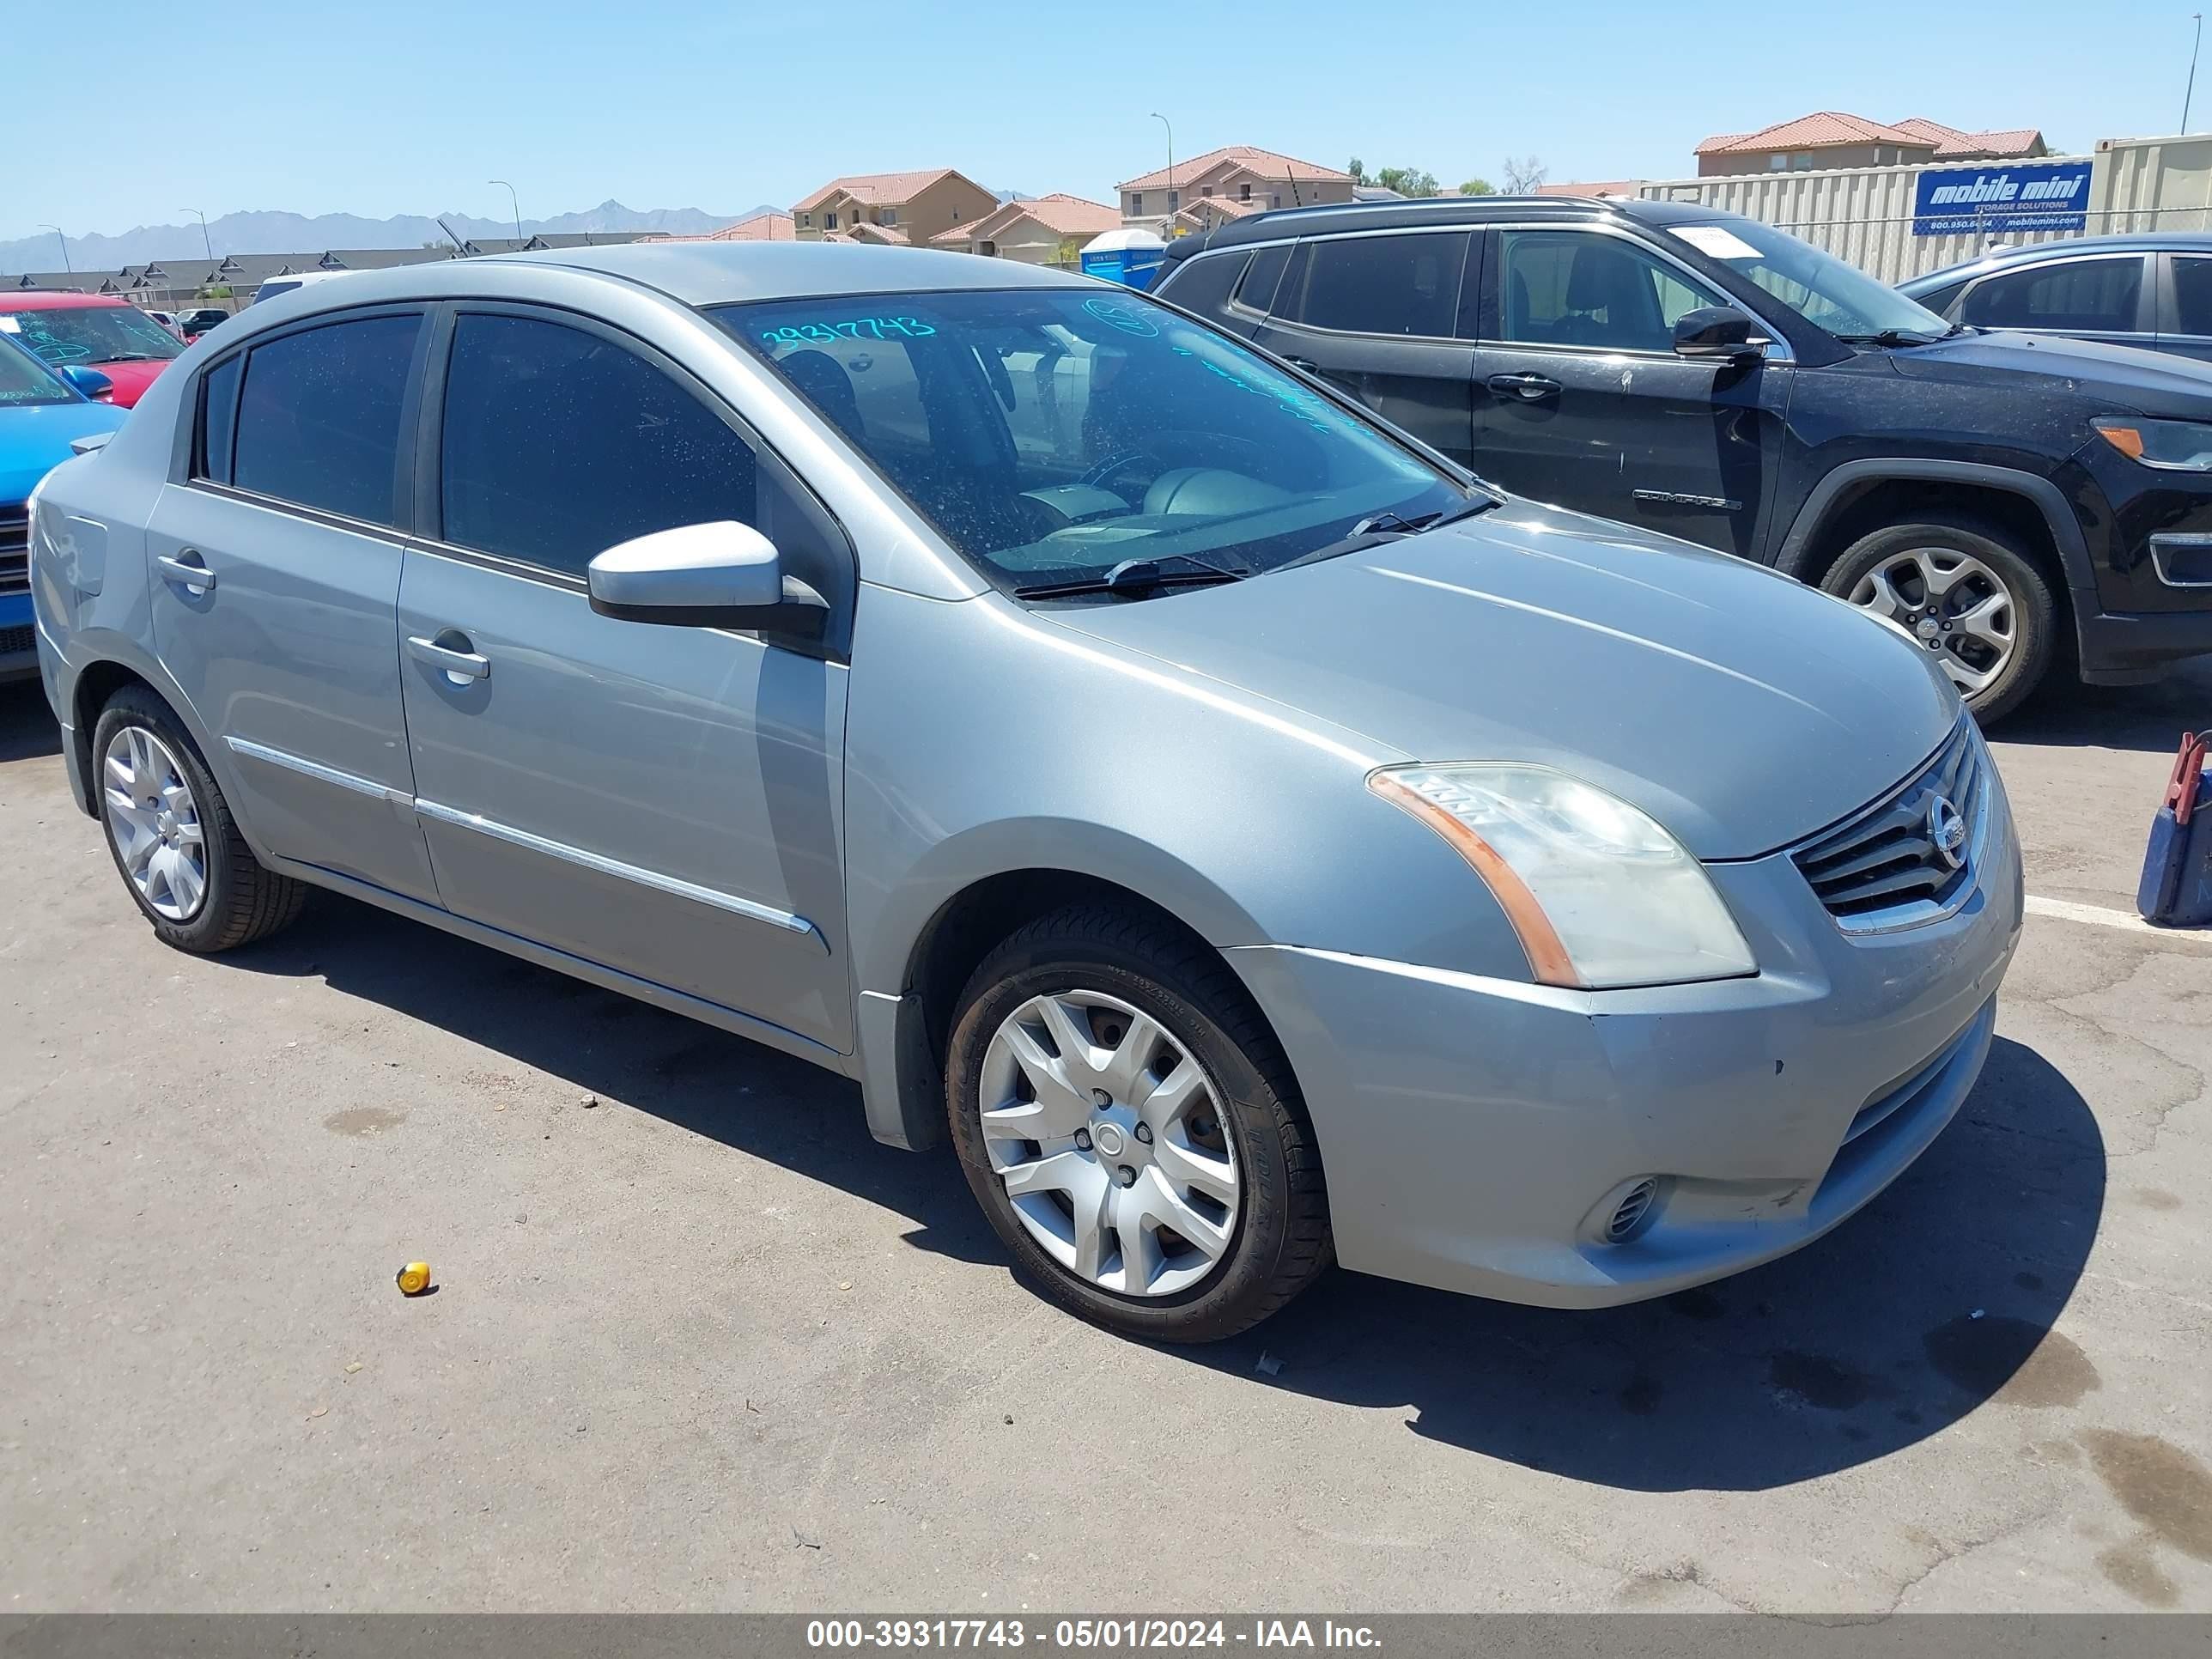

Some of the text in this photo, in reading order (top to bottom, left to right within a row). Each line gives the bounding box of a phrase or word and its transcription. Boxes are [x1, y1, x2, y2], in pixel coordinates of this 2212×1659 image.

[1929, 174, 2084, 204] mobile mini
[1974, 201, 2069, 212] STORAGE SOLUTIONS
[2006, 216, 2078, 227] mobilemini.com
[763, 317, 936, 350] 39317743
